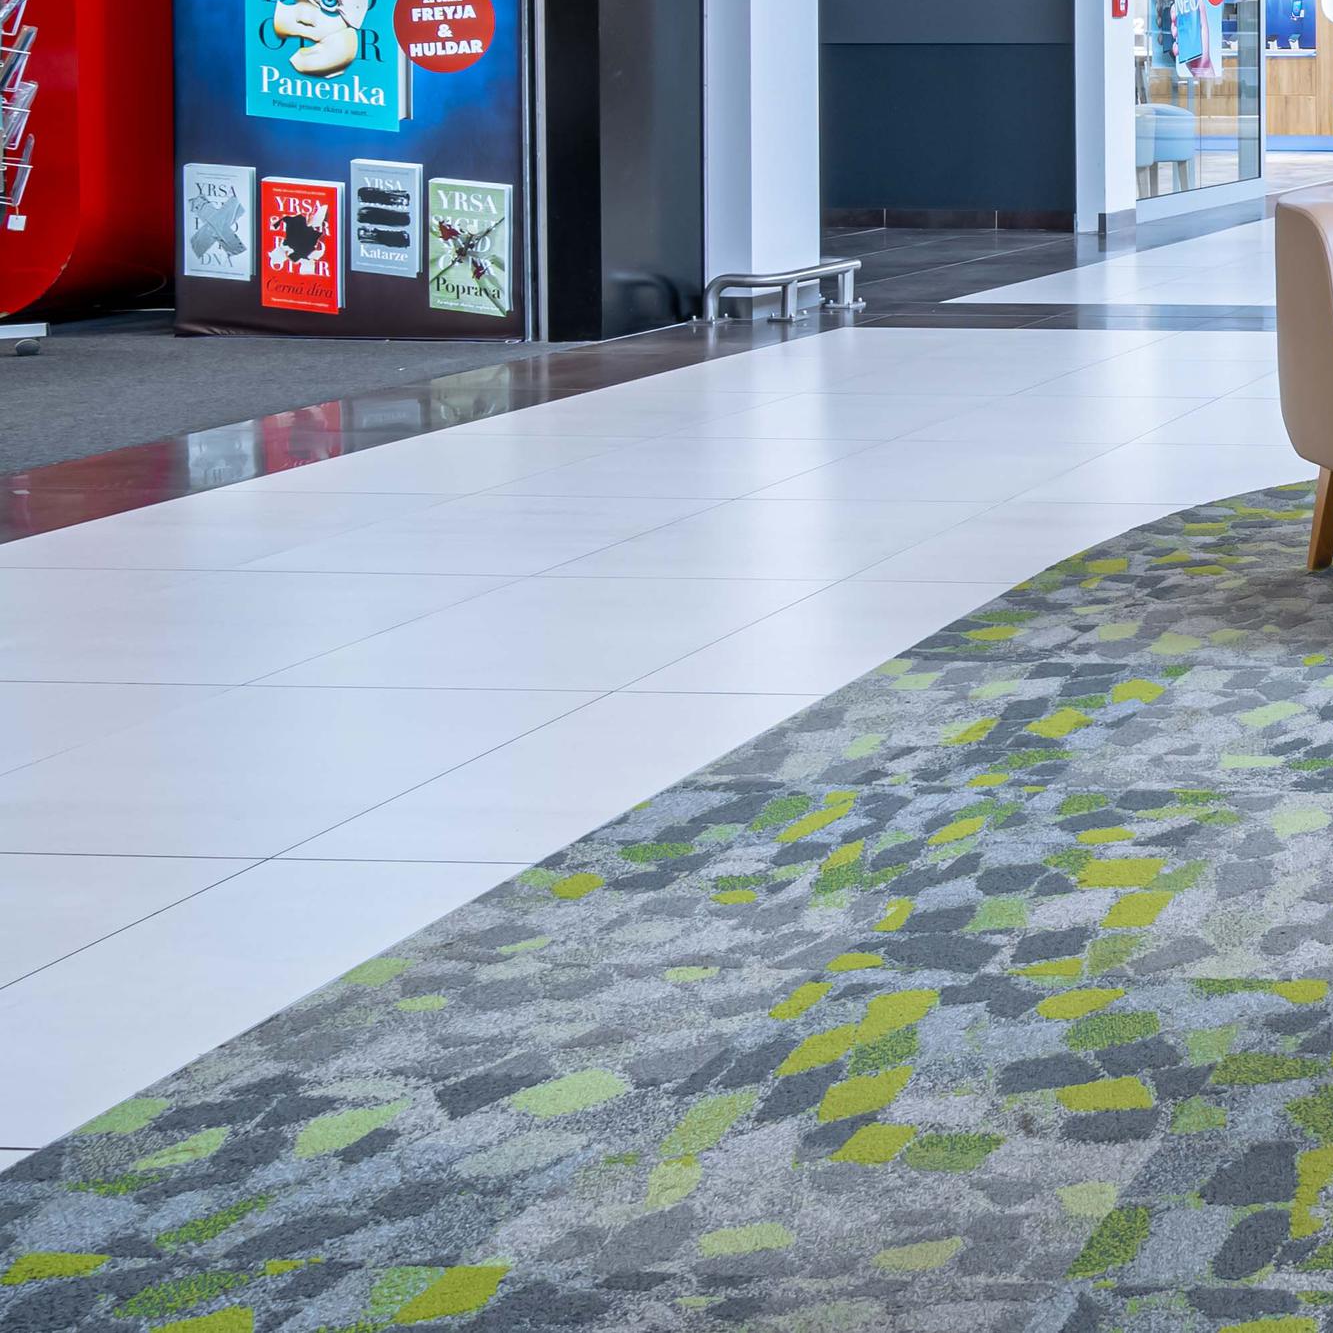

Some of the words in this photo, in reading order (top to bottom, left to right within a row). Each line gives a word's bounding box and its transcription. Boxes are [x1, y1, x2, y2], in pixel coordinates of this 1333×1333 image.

[411, 3, 477, 22] FREYJA
[437, 24, 453, 38] &
[409, 40, 484, 57] HULDAR
[260, 65, 386, 106] Panenka
[195, 182, 237, 198] YRSA
[364, 177, 404, 191] YRSA
[275, 196, 323, 213] YRSA
[437, 189, 498, 214] YRSA
[360, 244, 409, 262] Katarze
[266, 276, 303, 296] Černá
[306, 282, 334, 298] díra
[435, 275, 502, 299] Poprava
